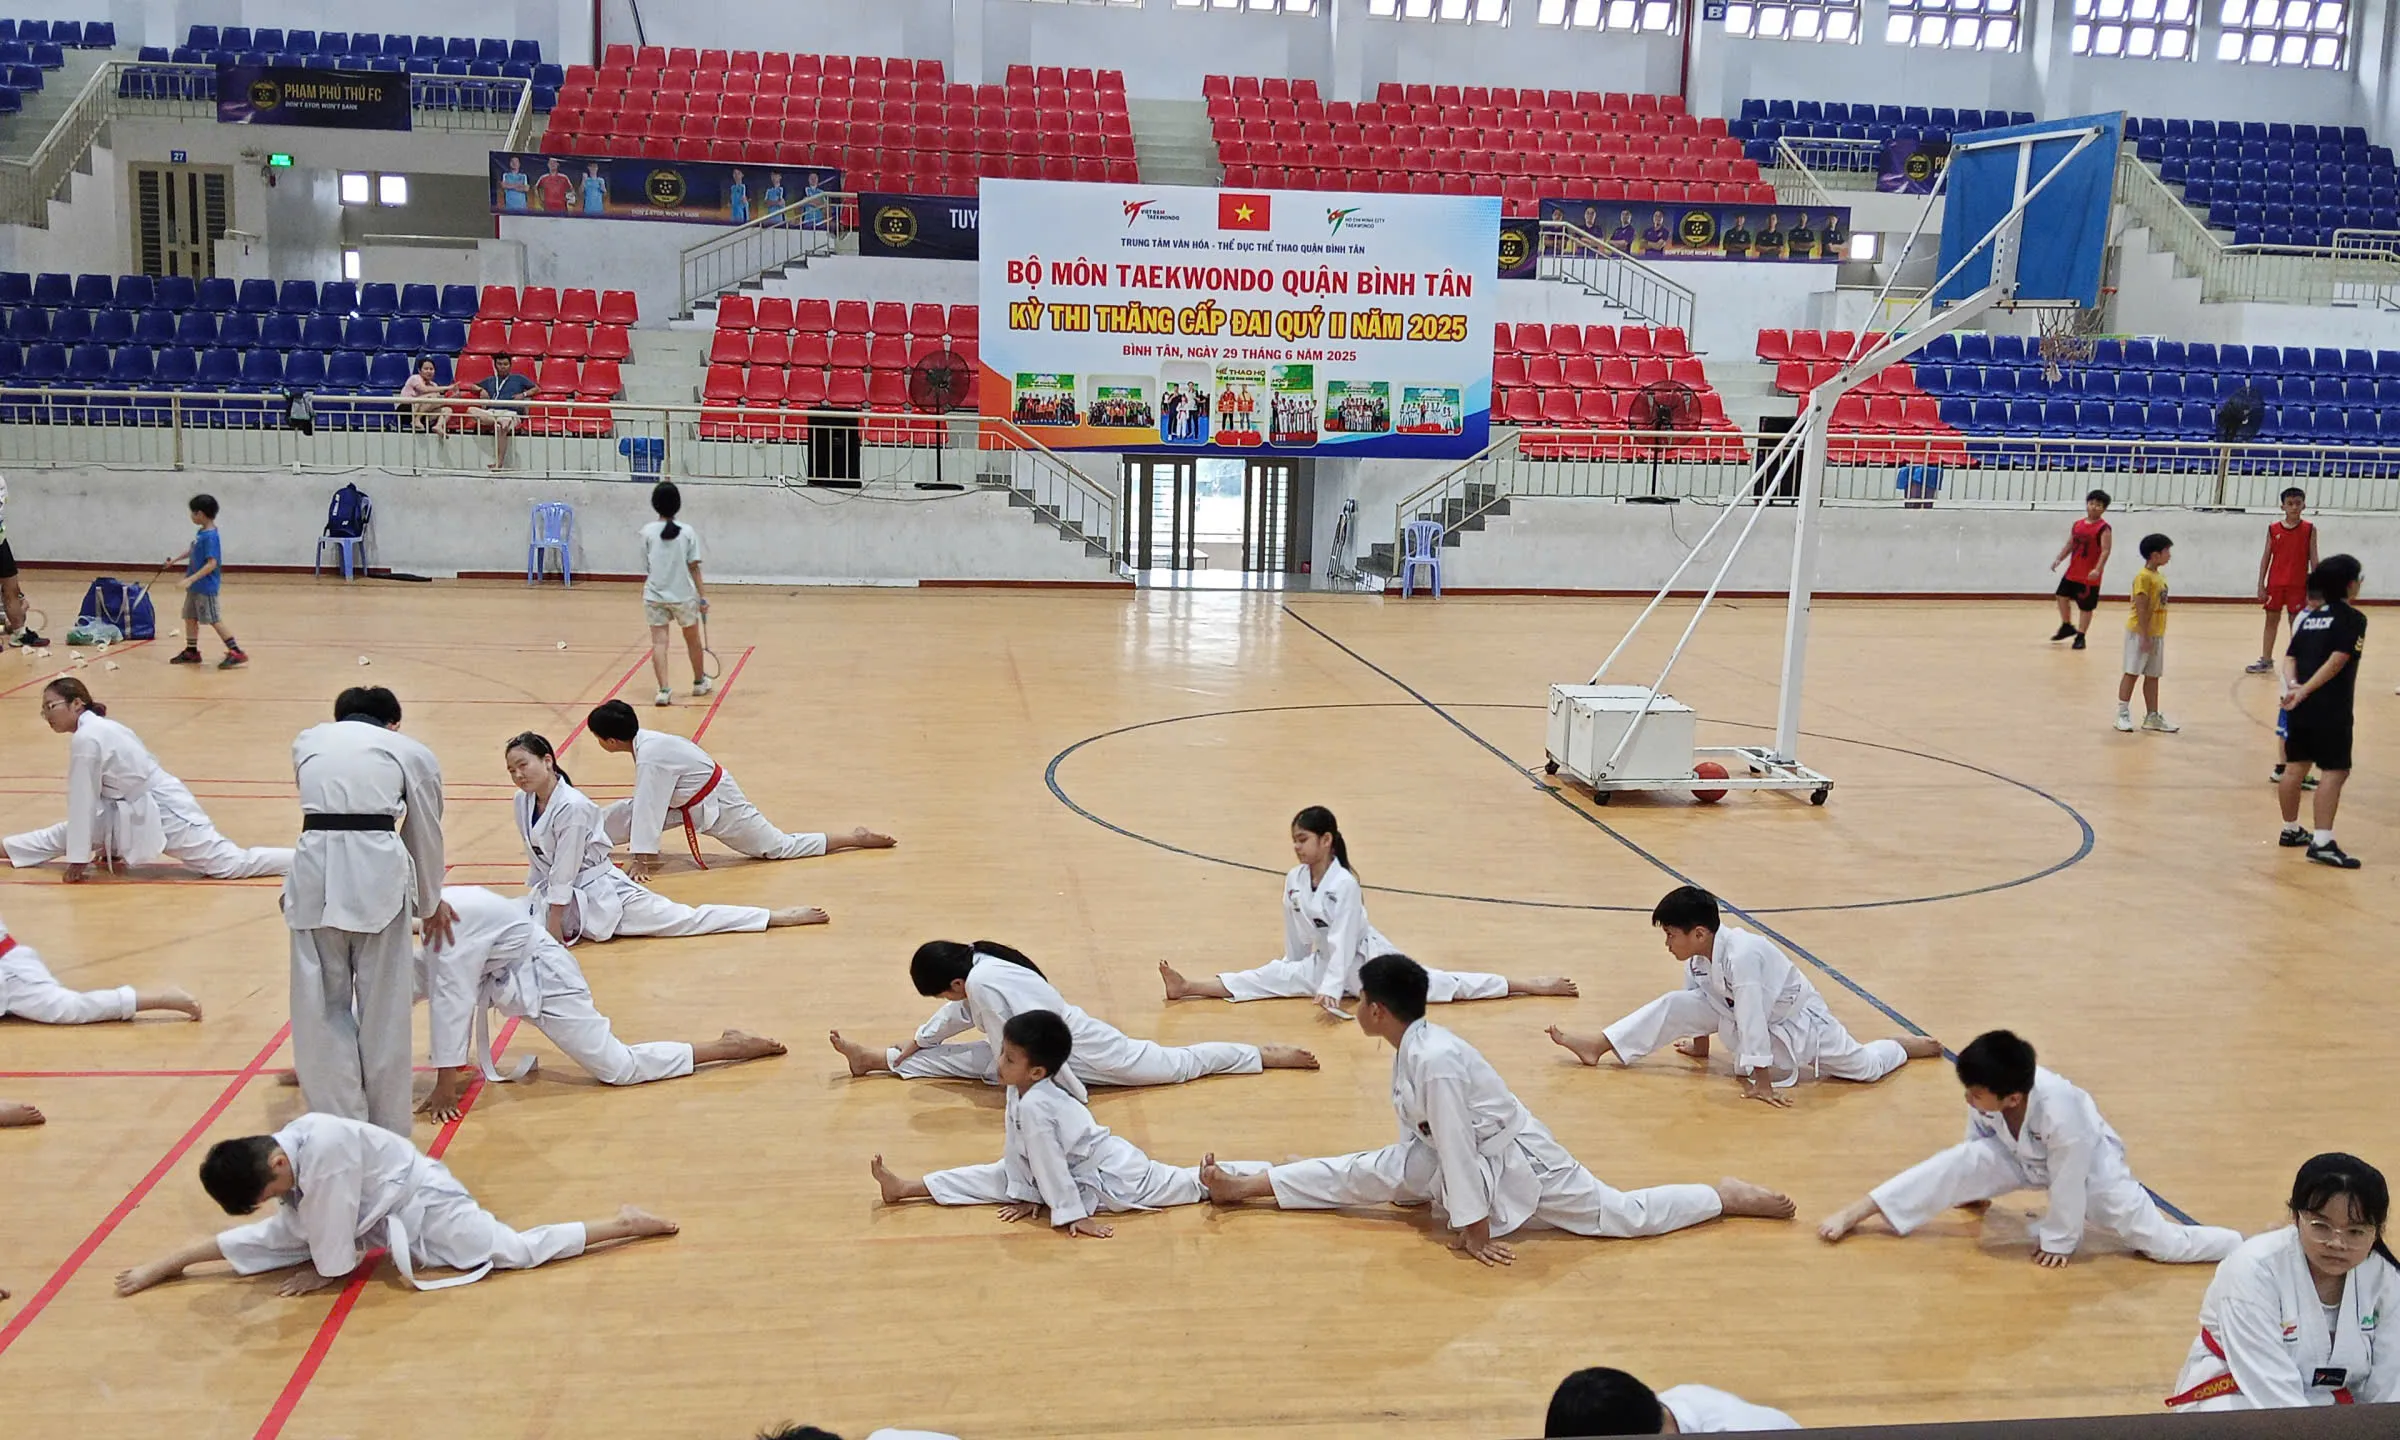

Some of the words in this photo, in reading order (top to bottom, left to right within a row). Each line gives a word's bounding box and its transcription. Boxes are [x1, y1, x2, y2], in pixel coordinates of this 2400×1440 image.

[1708, 6, 1723, 18] B
[368, 87, 382, 102] FC
[174, 152, 184, 160] 27
[1121, 238, 1150, 248] TRUNG
[1152, 237, 1170, 248] TÂM
[1192, 239, 1210, 250] HÓA
[1237, 242, 1254, 252] DỤC
[1276, 243, 1298, 252] THAO
[1300, 243, 1324, 255] QUẬN
[1326, 243, 1346, 254] BÌNH
[1348, 244, 1365, 254] TÂN
[1008, 255, 1042, 290] BỘ
[1052, 256, 1107, 287] MÔN
[1116, 264, 1274, 292] TAEKWONDO
[1282, 264, 1348, 298] QUẬN
[1357, 266, 1416, 296] BÌNH
[1424, 268, 1472, 298] TÂN
[1009, 296, 1044, 331] KỲ
[1048, 303, 1090, 331] THI
[1095, 301, 1174, 334] THĂNG
[1178, 299, 1226, 336] CẤP
[1231, 309, 1272, 338] ĐAI
[1276, 305, 1324, 342] QUÝ
[1328, 311, 1346, 339] II
[1350, 308, 1403, 340] NĂM
[1406, 314, 1468, 342] 2025
[1123, 343, 1152, 356] BÌNH
[1156, 344, 1183, 358] TÂN,
[1188, 344, 1218, 358] NGÀY
[1222, 348, 1238, 359] 29
[1242, 346, 1282, 360] THÁNG
[1286, 350, 1292, 360] 6
[1296, 348, 1322, 360] NĂM
[1327, 350, 1357, 361] 2025
